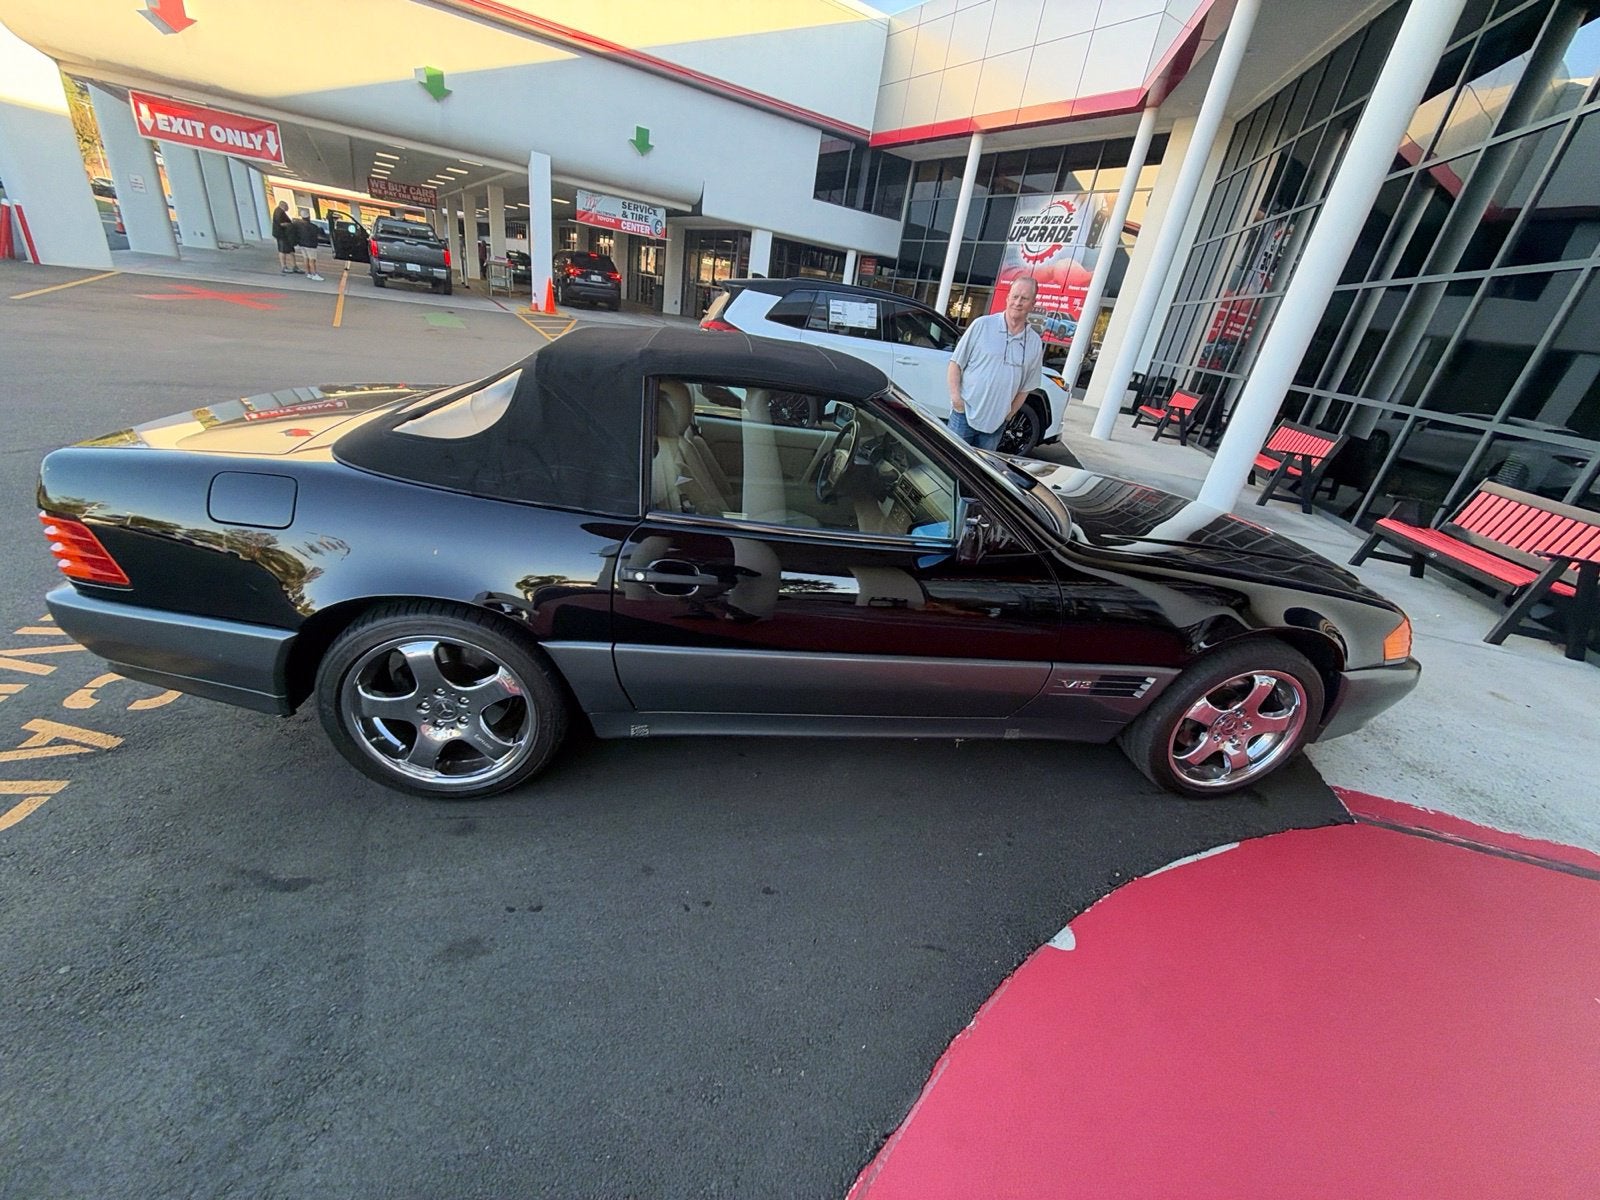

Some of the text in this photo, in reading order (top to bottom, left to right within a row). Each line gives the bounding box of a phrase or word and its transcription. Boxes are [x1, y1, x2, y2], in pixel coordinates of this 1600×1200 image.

[154, 113, 263, 151] EXIT ONLY
[369, 179, 435, 199] WE BUY CARS
[621, 201, 658, 217] SERVICE
[621, 210, 629, 219] &
[630, 212, 650, 223] TIRE
[597, 215, 615, 223] TOYOTA
[1016, 213, 1073, 224] SHIFT OVER &
[621, 220, 651, 235] CENTER
[1009, 225, 1079, 243] UPGRADE
[1061, 680, 1092, 689] V12
